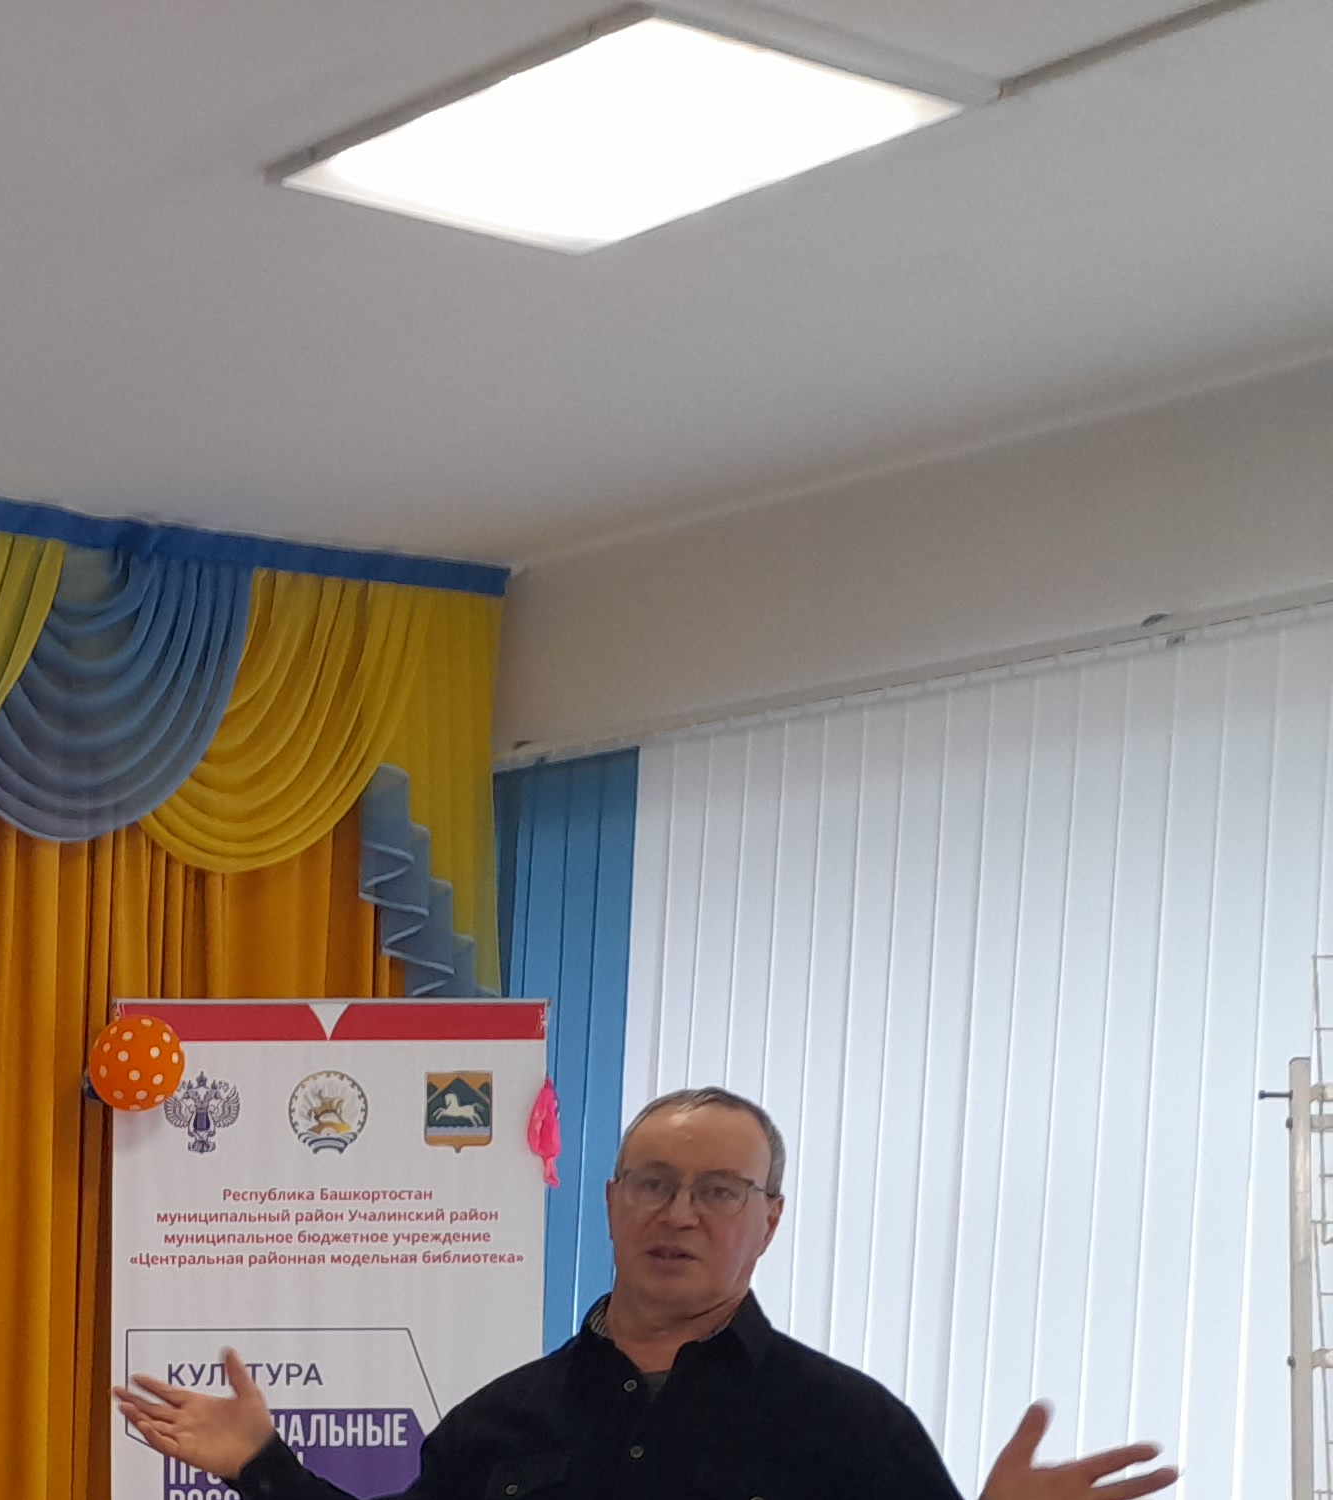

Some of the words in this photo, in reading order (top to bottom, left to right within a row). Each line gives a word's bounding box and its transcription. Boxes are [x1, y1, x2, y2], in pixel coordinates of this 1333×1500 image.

[222, 1187, 315, 1204] Республика
[320, 1187, 433, 1204] Башкортостан
[156, 1208, 290, 1226] муниципальный
[294, 1208, 344, 1225] район
[348, 1207, 445, 1222] Учалинский
[449, 1207, 499, 1224] район
[164, 1232, 293, 1247] муниципальное
[297, 1230, 389, 1245] бюджетное
[393, 1231, 491, 1246] учреждение
[130, 1252, 244, 1268] «Центральная
[248, 1251, 326, 1268] районная
[330, 1252, 418, 1267] модельная
[422, 1250, 524, 1265] библиотека»
[167, 1362, 324, 1387] КУЛТУРА
